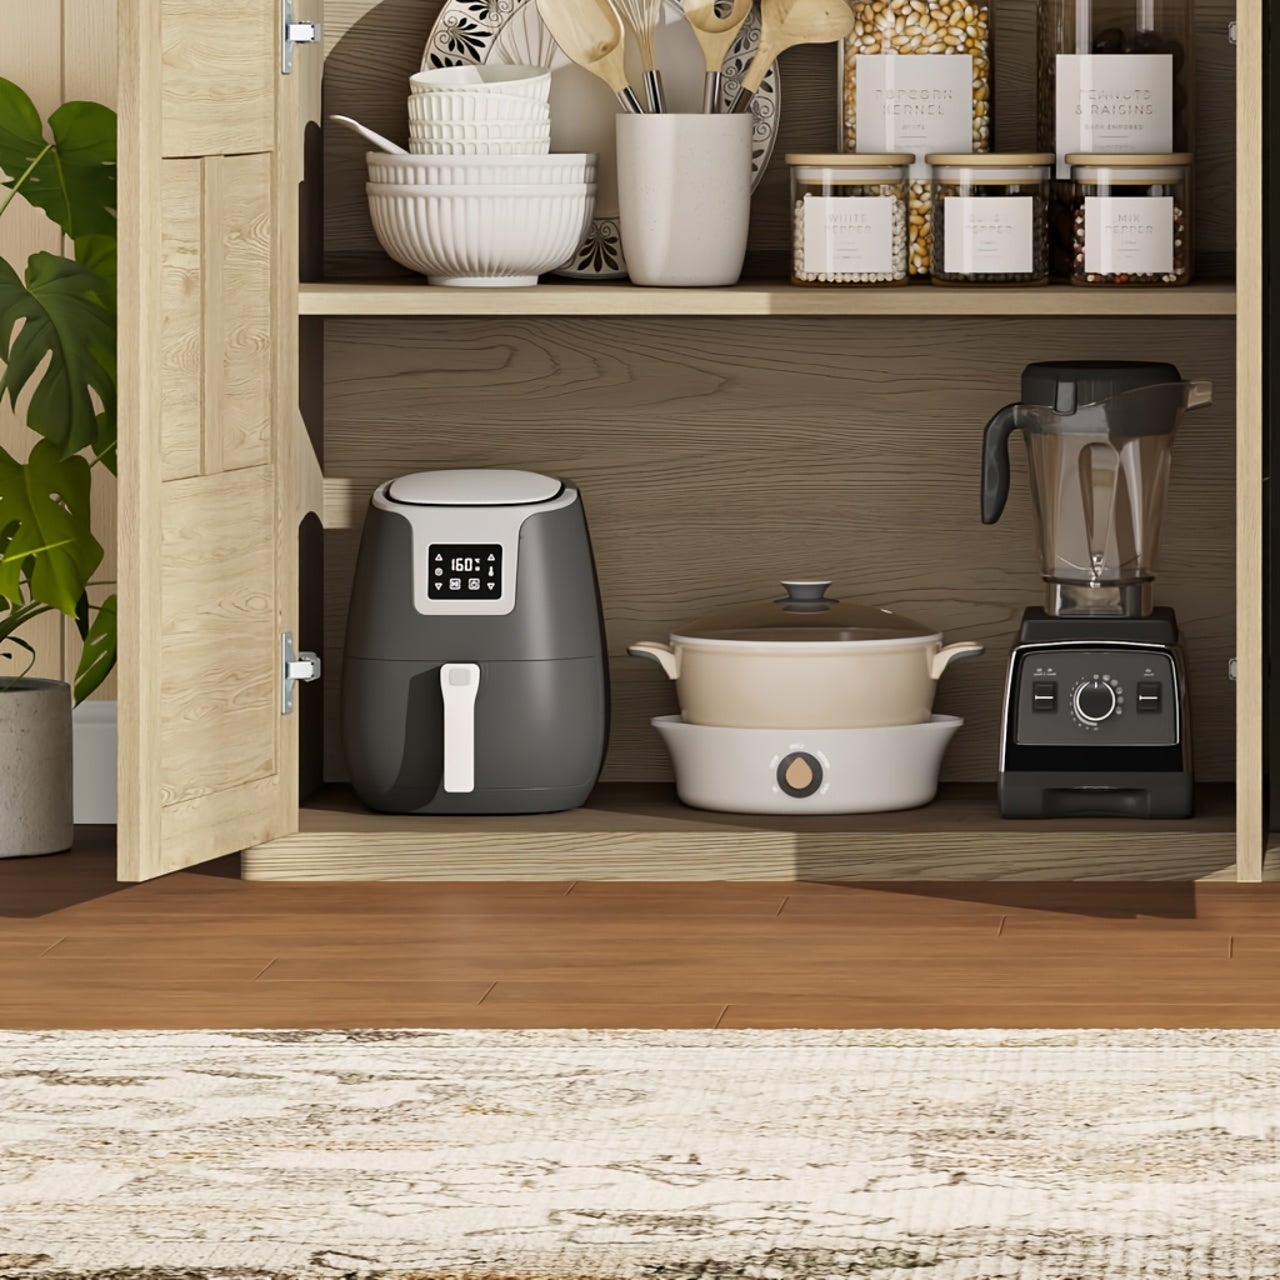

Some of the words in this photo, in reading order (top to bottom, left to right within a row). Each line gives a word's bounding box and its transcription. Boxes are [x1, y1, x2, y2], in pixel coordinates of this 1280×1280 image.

[882, 104, 945, 116] KERNEL
[1090, 104, 1153, 115] RAISINS
[451, 557, 473, 572] 160
